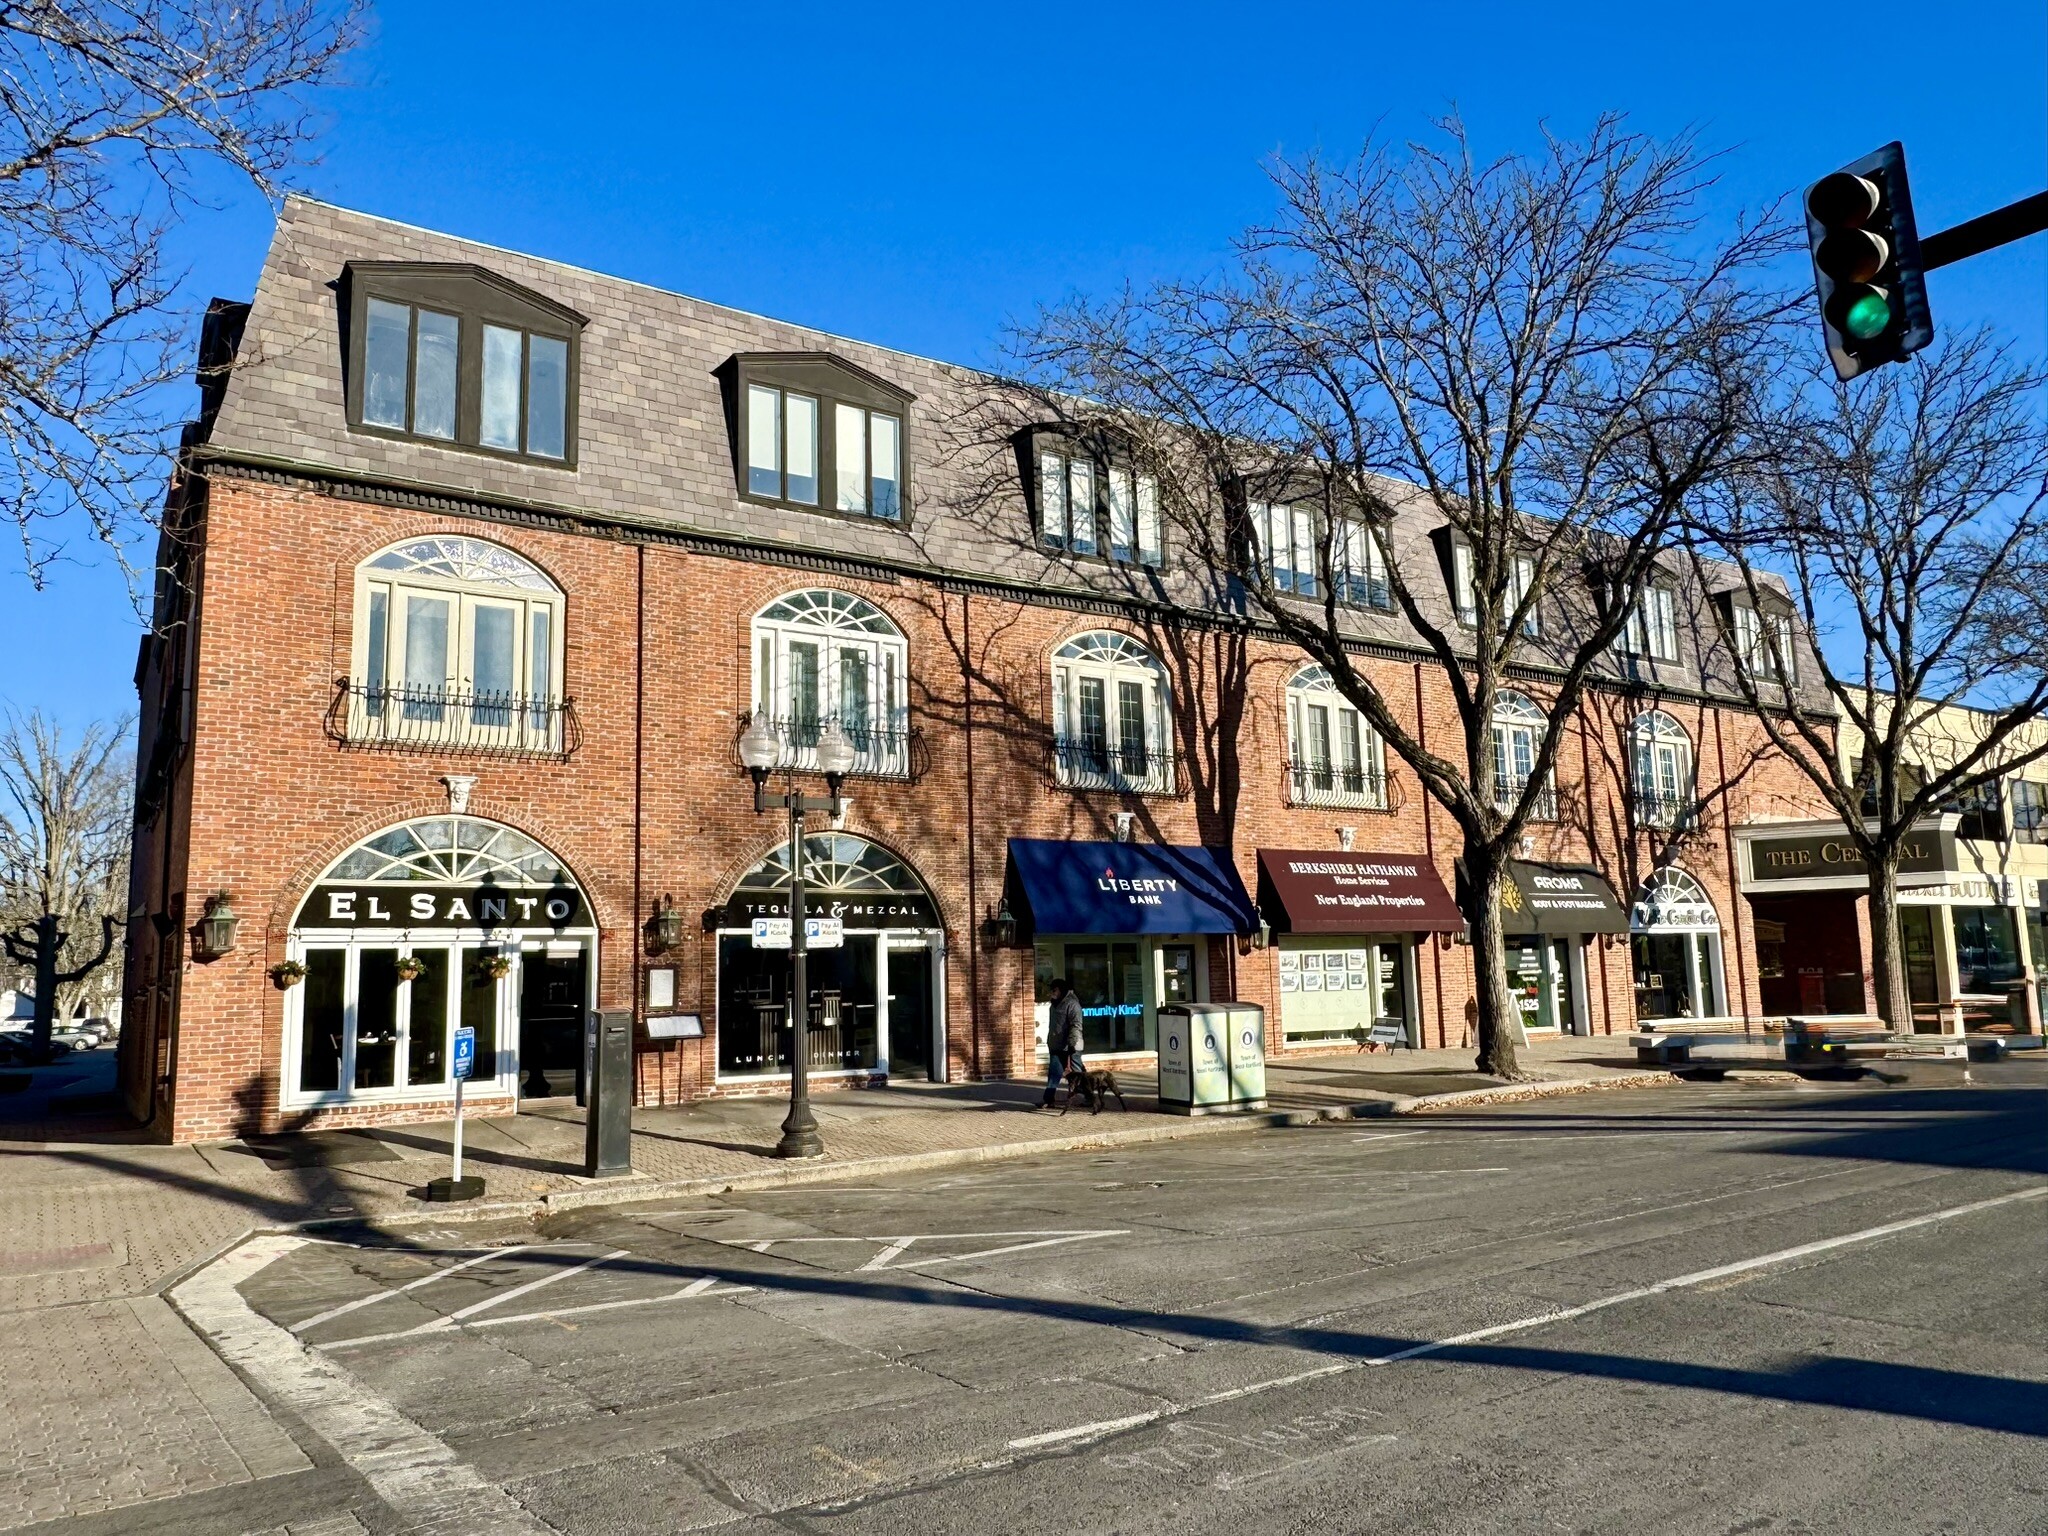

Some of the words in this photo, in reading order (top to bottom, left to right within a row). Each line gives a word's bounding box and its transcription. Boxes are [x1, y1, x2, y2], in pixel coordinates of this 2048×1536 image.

[1766, 850, 1811, 866] THE
[1821, 842, 1929, 864] CENAL
[1289, 862, 1356, 875] BERKSHIRE
[1356, 864, 1418, 876] HATHAWAY
[1098, 878, 1177, 892] LIBERTY
[1333, 876, 1358, 885] Home
[1358, 877, 1389, 885] Services
[1533, 876, 1583, 889] AROMA
[328, 892, 391, 920] EL
[409, 893, 570, 920] SANTO
[1129, 895, 1162, 904] BANK
[1315, 895, 1338, 906] New
[1338, 895, 1379, 907] England
[1377, 895, 1425, 907] Properties
[1532, 900, 1552, 908] BODY
[1558, 900, 1576, 908] FOOT
[746, 904, 824, 914] TEQULA
[830, 901, 849, 919] &
[853, 905, 919, 915] MEZCAL
[735, 1054, 785, 1063] LUNCH
[813, 1050, 860, 1059] DINNER
